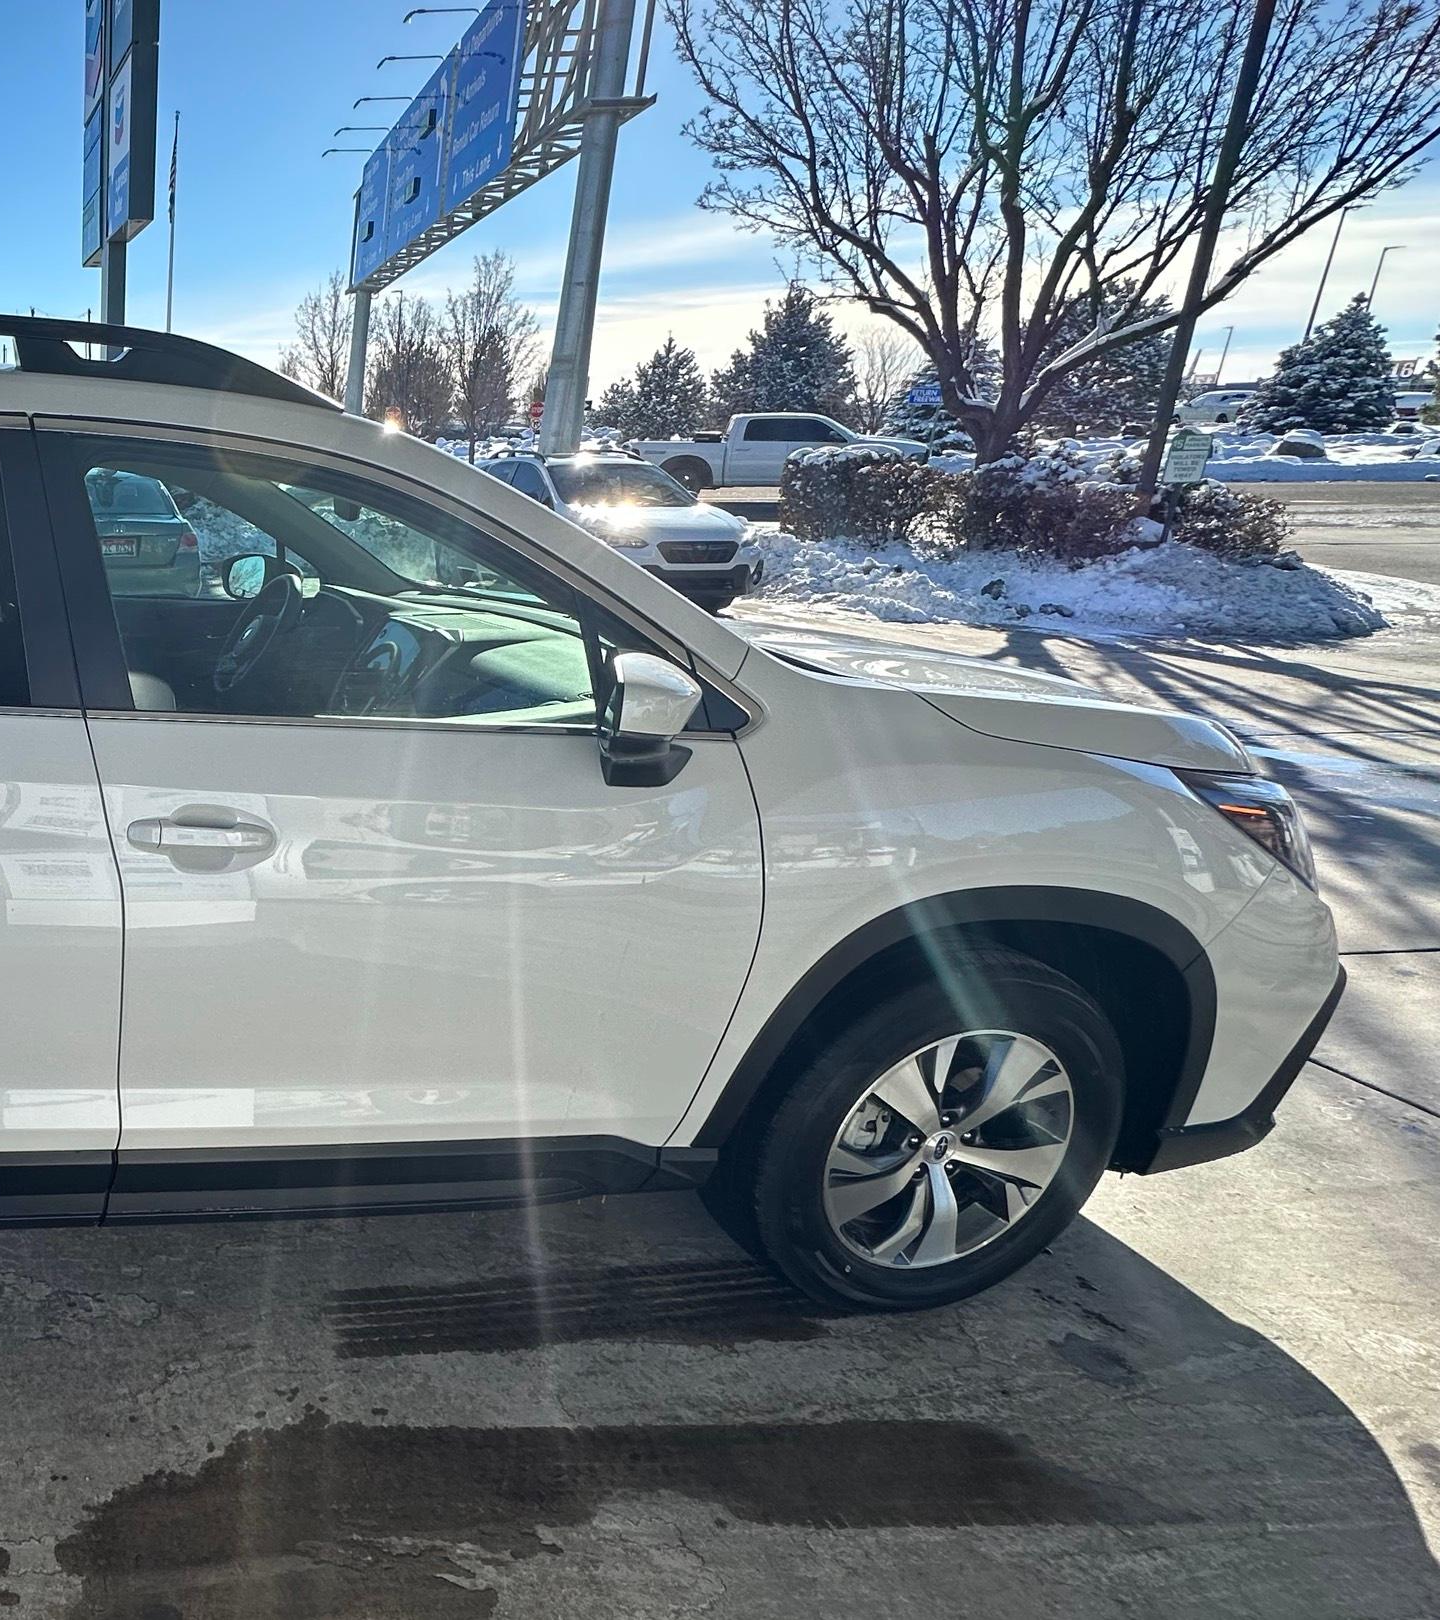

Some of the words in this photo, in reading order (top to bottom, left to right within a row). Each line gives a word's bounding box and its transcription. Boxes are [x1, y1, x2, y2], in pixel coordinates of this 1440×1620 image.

[469, 119, 480, 143] Car
[480, 101, 500, 133] Return
[462, 167, 475, 190] This
[475, 153, 491, 179] Lane
[1388, 361, 1415, 378] 16
